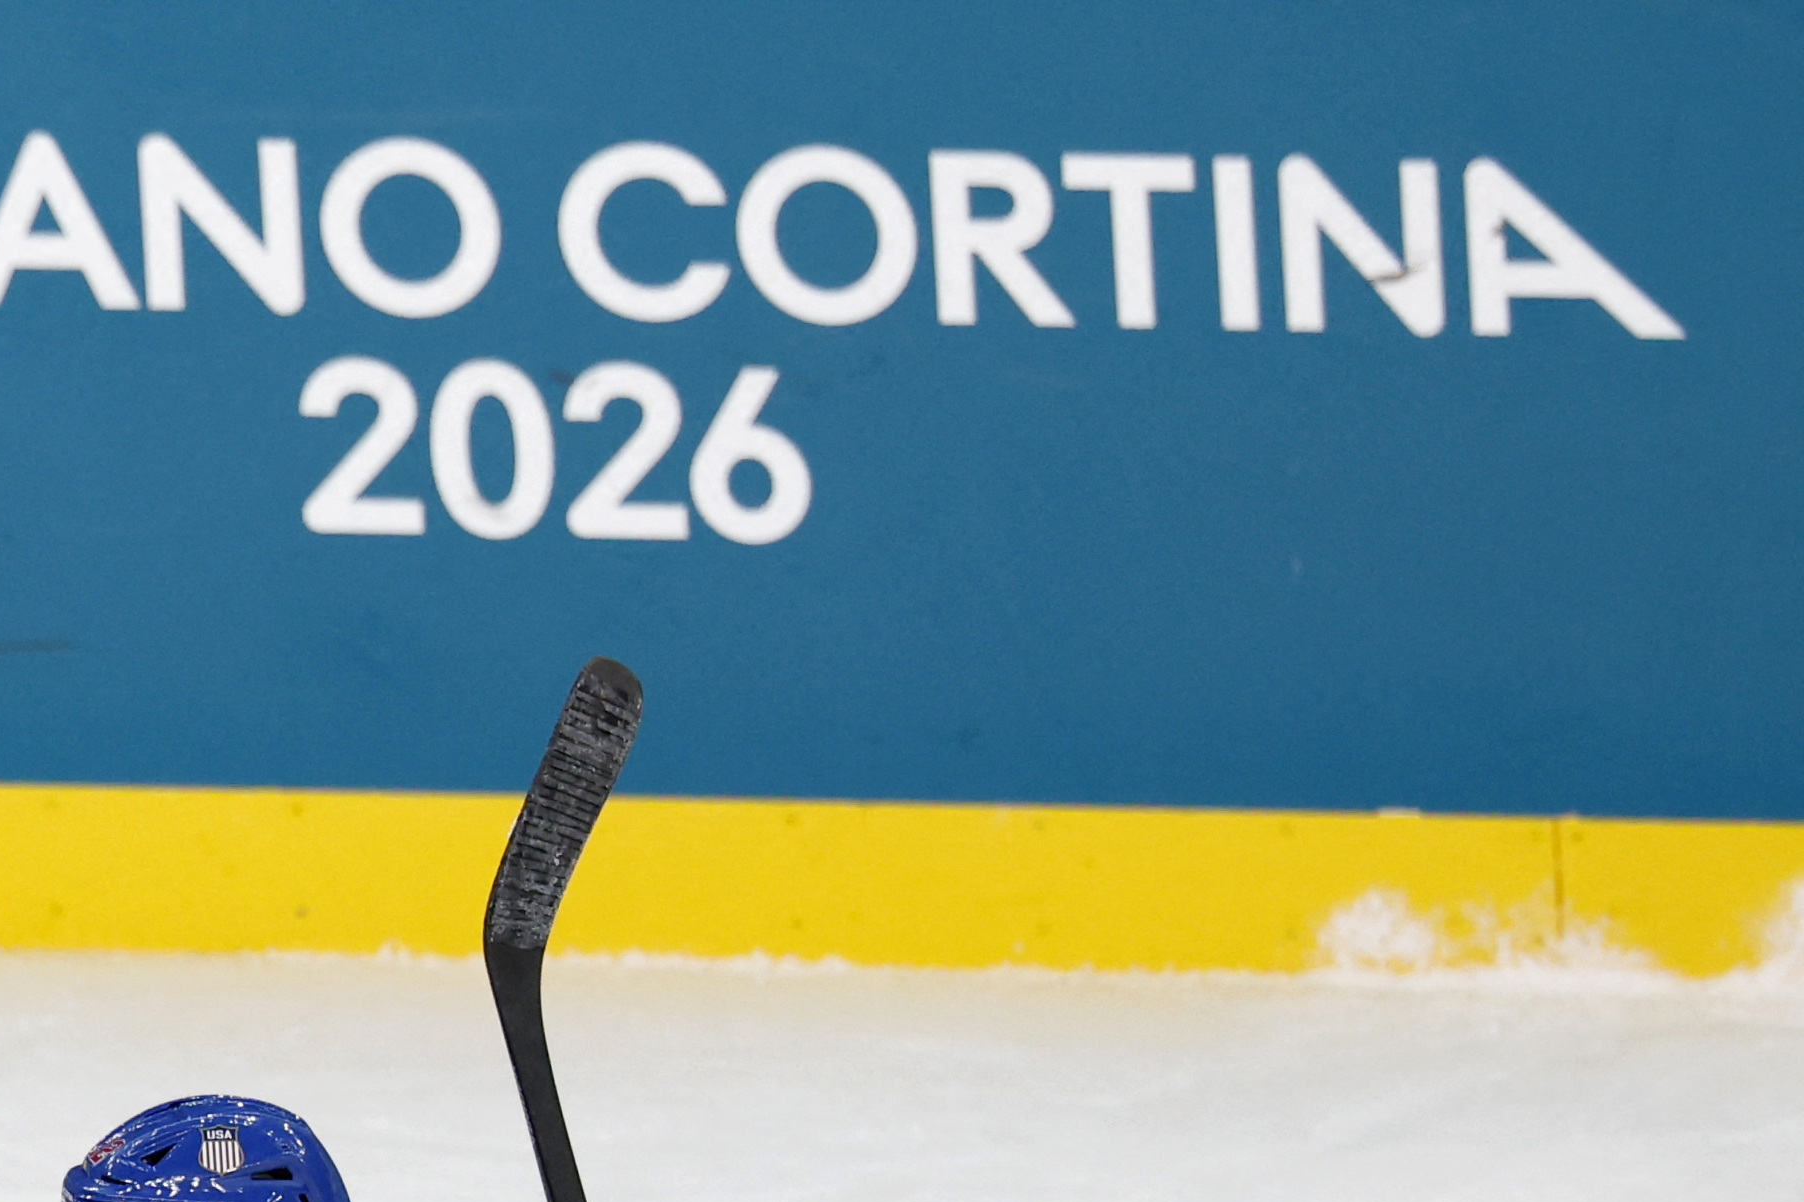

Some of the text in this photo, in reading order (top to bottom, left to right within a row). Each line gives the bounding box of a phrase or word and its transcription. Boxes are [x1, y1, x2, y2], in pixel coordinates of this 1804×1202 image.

[557, 140, 1687, 340] CORTINA
[297, 356, 813, 545] 2026
[206, 1130, 233, 1140] USA
